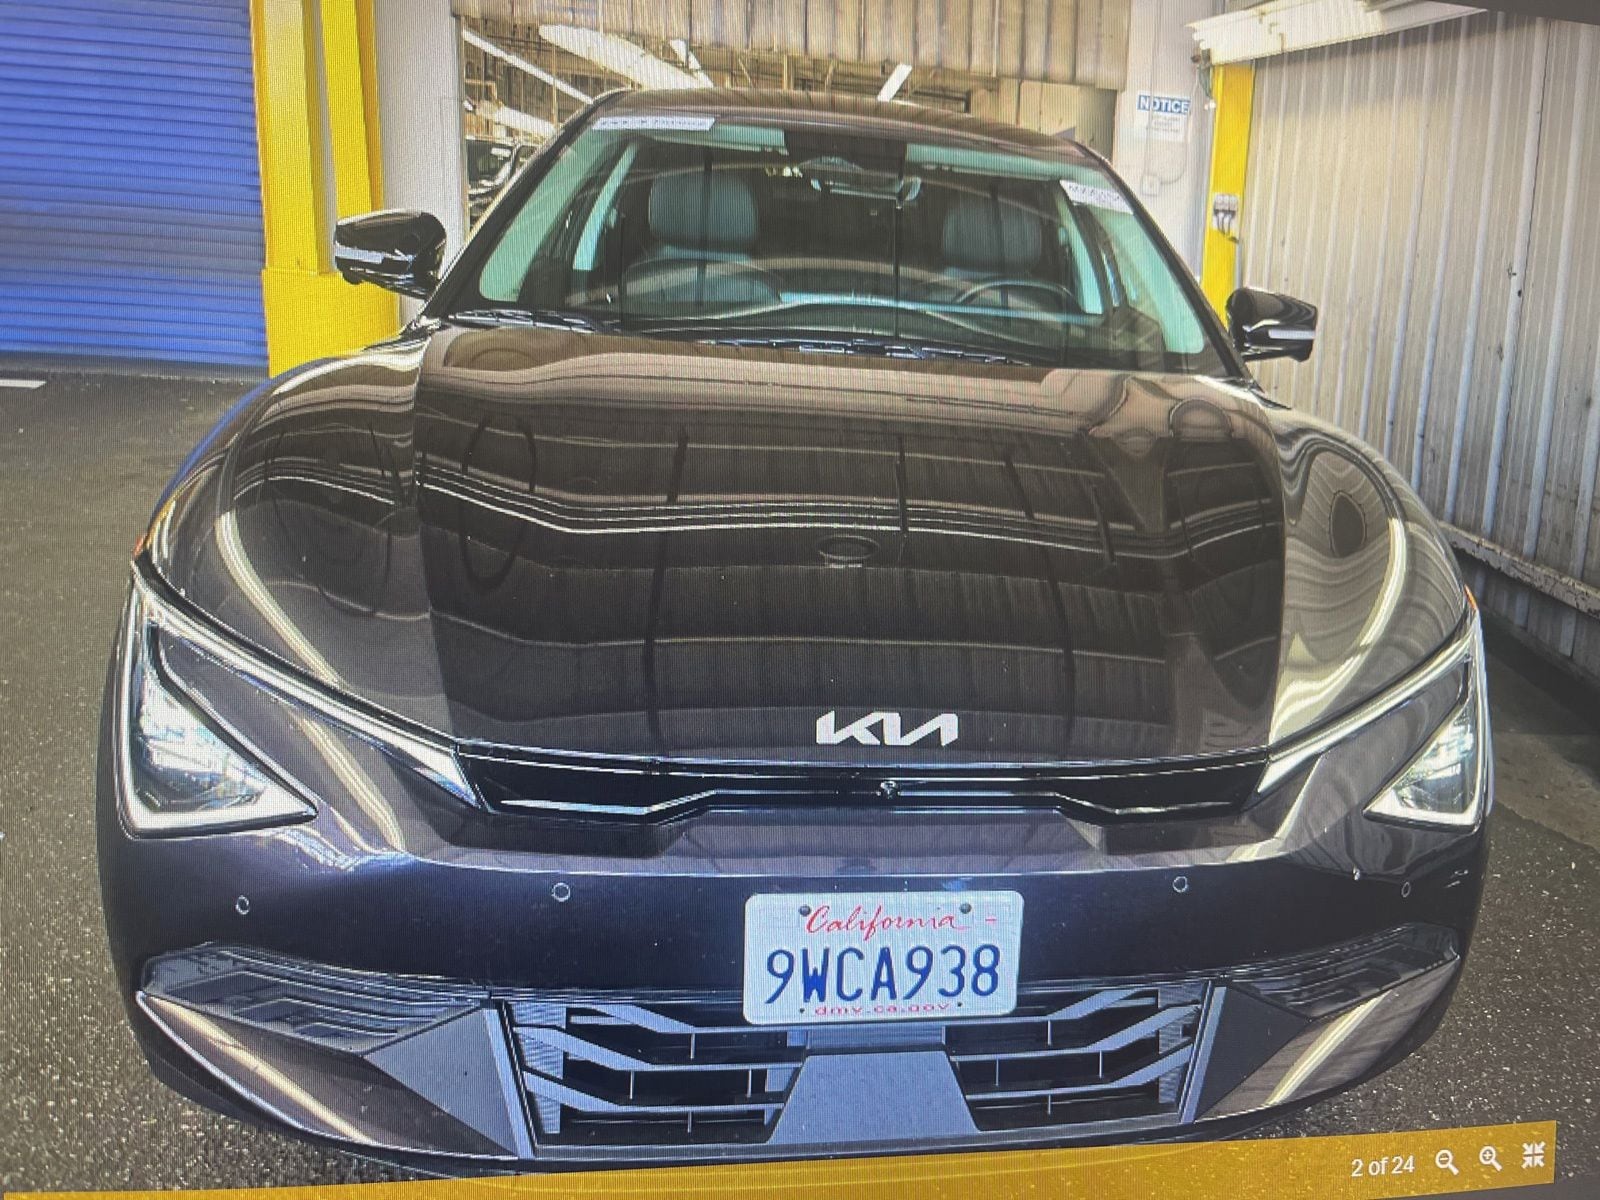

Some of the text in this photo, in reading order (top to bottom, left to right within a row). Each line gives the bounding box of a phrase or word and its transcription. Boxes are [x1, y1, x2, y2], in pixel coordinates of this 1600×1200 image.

[1139, 95, 1189, 114] NOTICE
[816, 711, 958, 747] KIA
[806, 905, 970, 941] California
[766, 944, 1000, 1004] 9WCA938
[814, 1002, 950, 1016] dmv.ca.gov
[1351, 1155, 1415, 1177] 2 of 24
